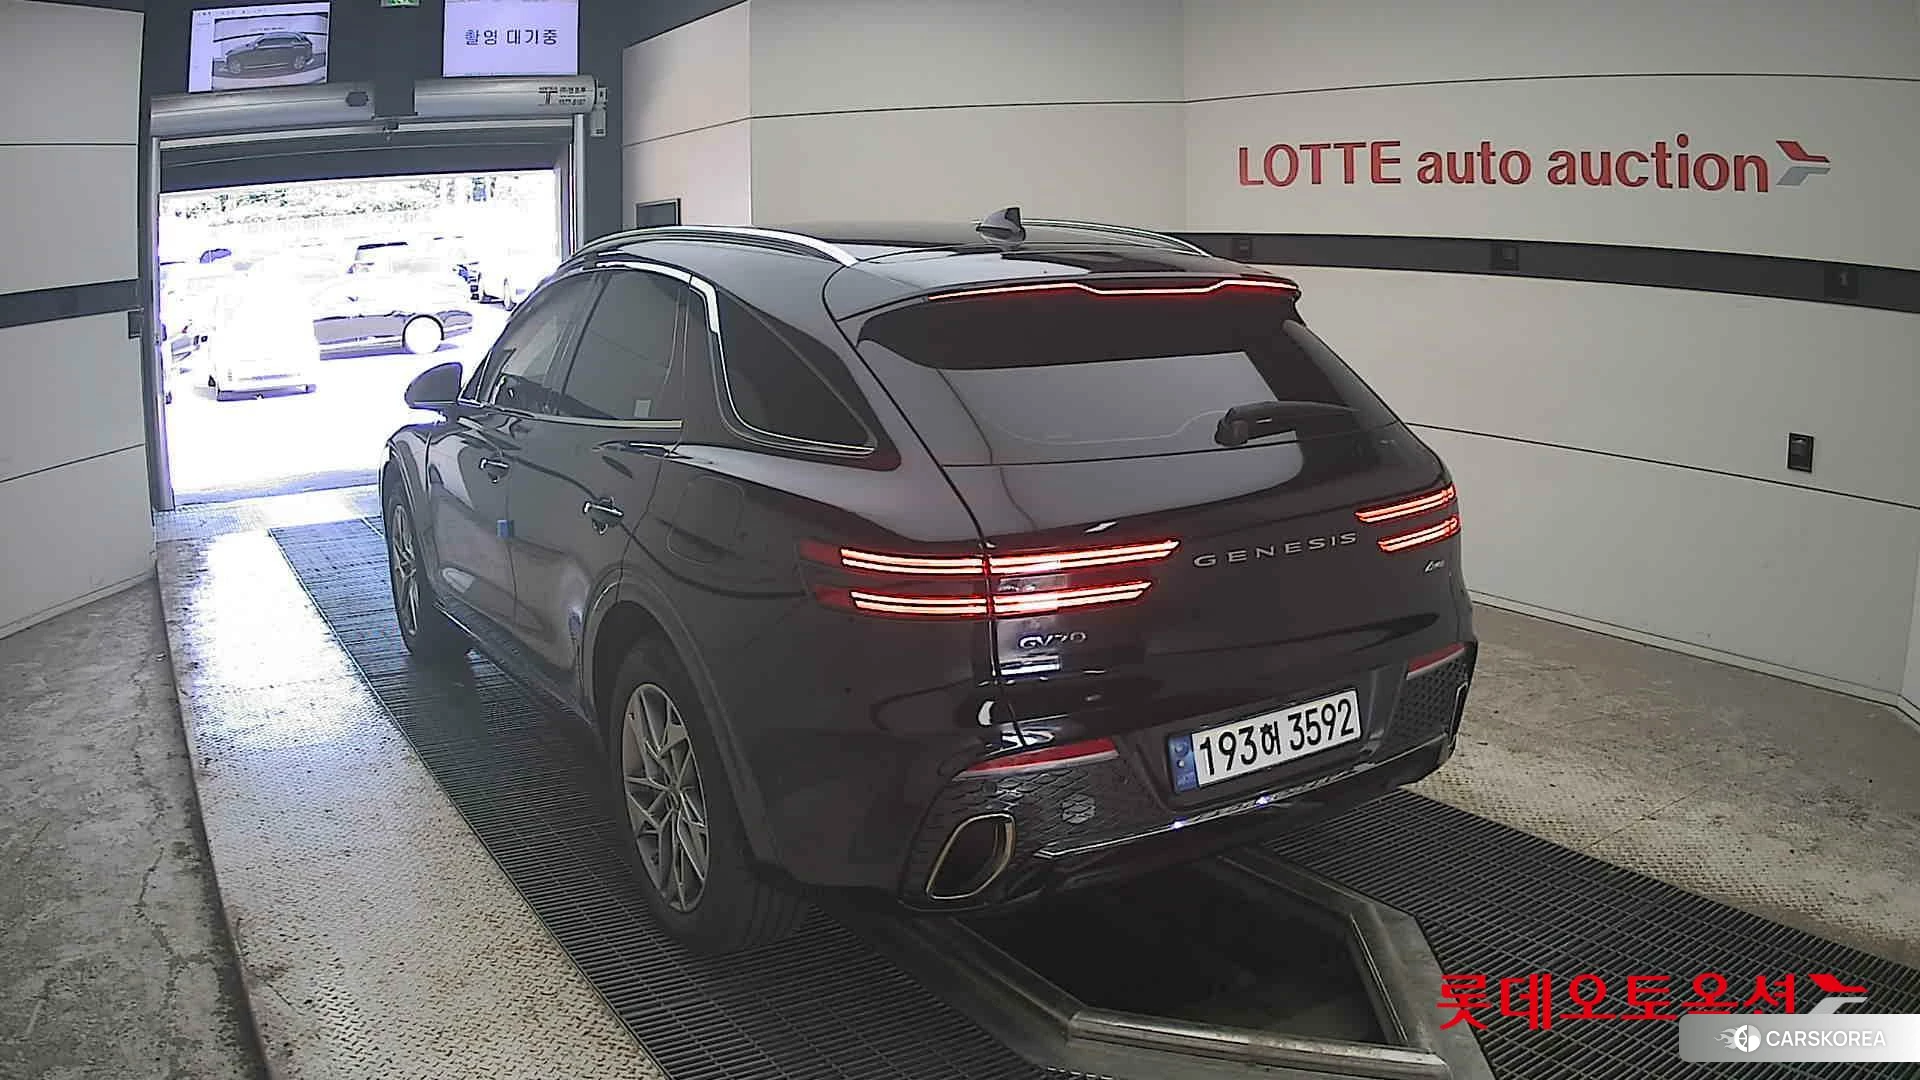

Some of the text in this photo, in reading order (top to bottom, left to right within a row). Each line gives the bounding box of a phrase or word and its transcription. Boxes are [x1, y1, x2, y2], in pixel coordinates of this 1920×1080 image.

[506, 29, 557, 46] 대기중
[1239, 134, 1769, 193] LOTTE auto auction
[1193, 532, 1357, 567] GENESIS
[1019, 631, 1087, 649] GV70
[1200, 698, 1354, 776] 193허 3592
